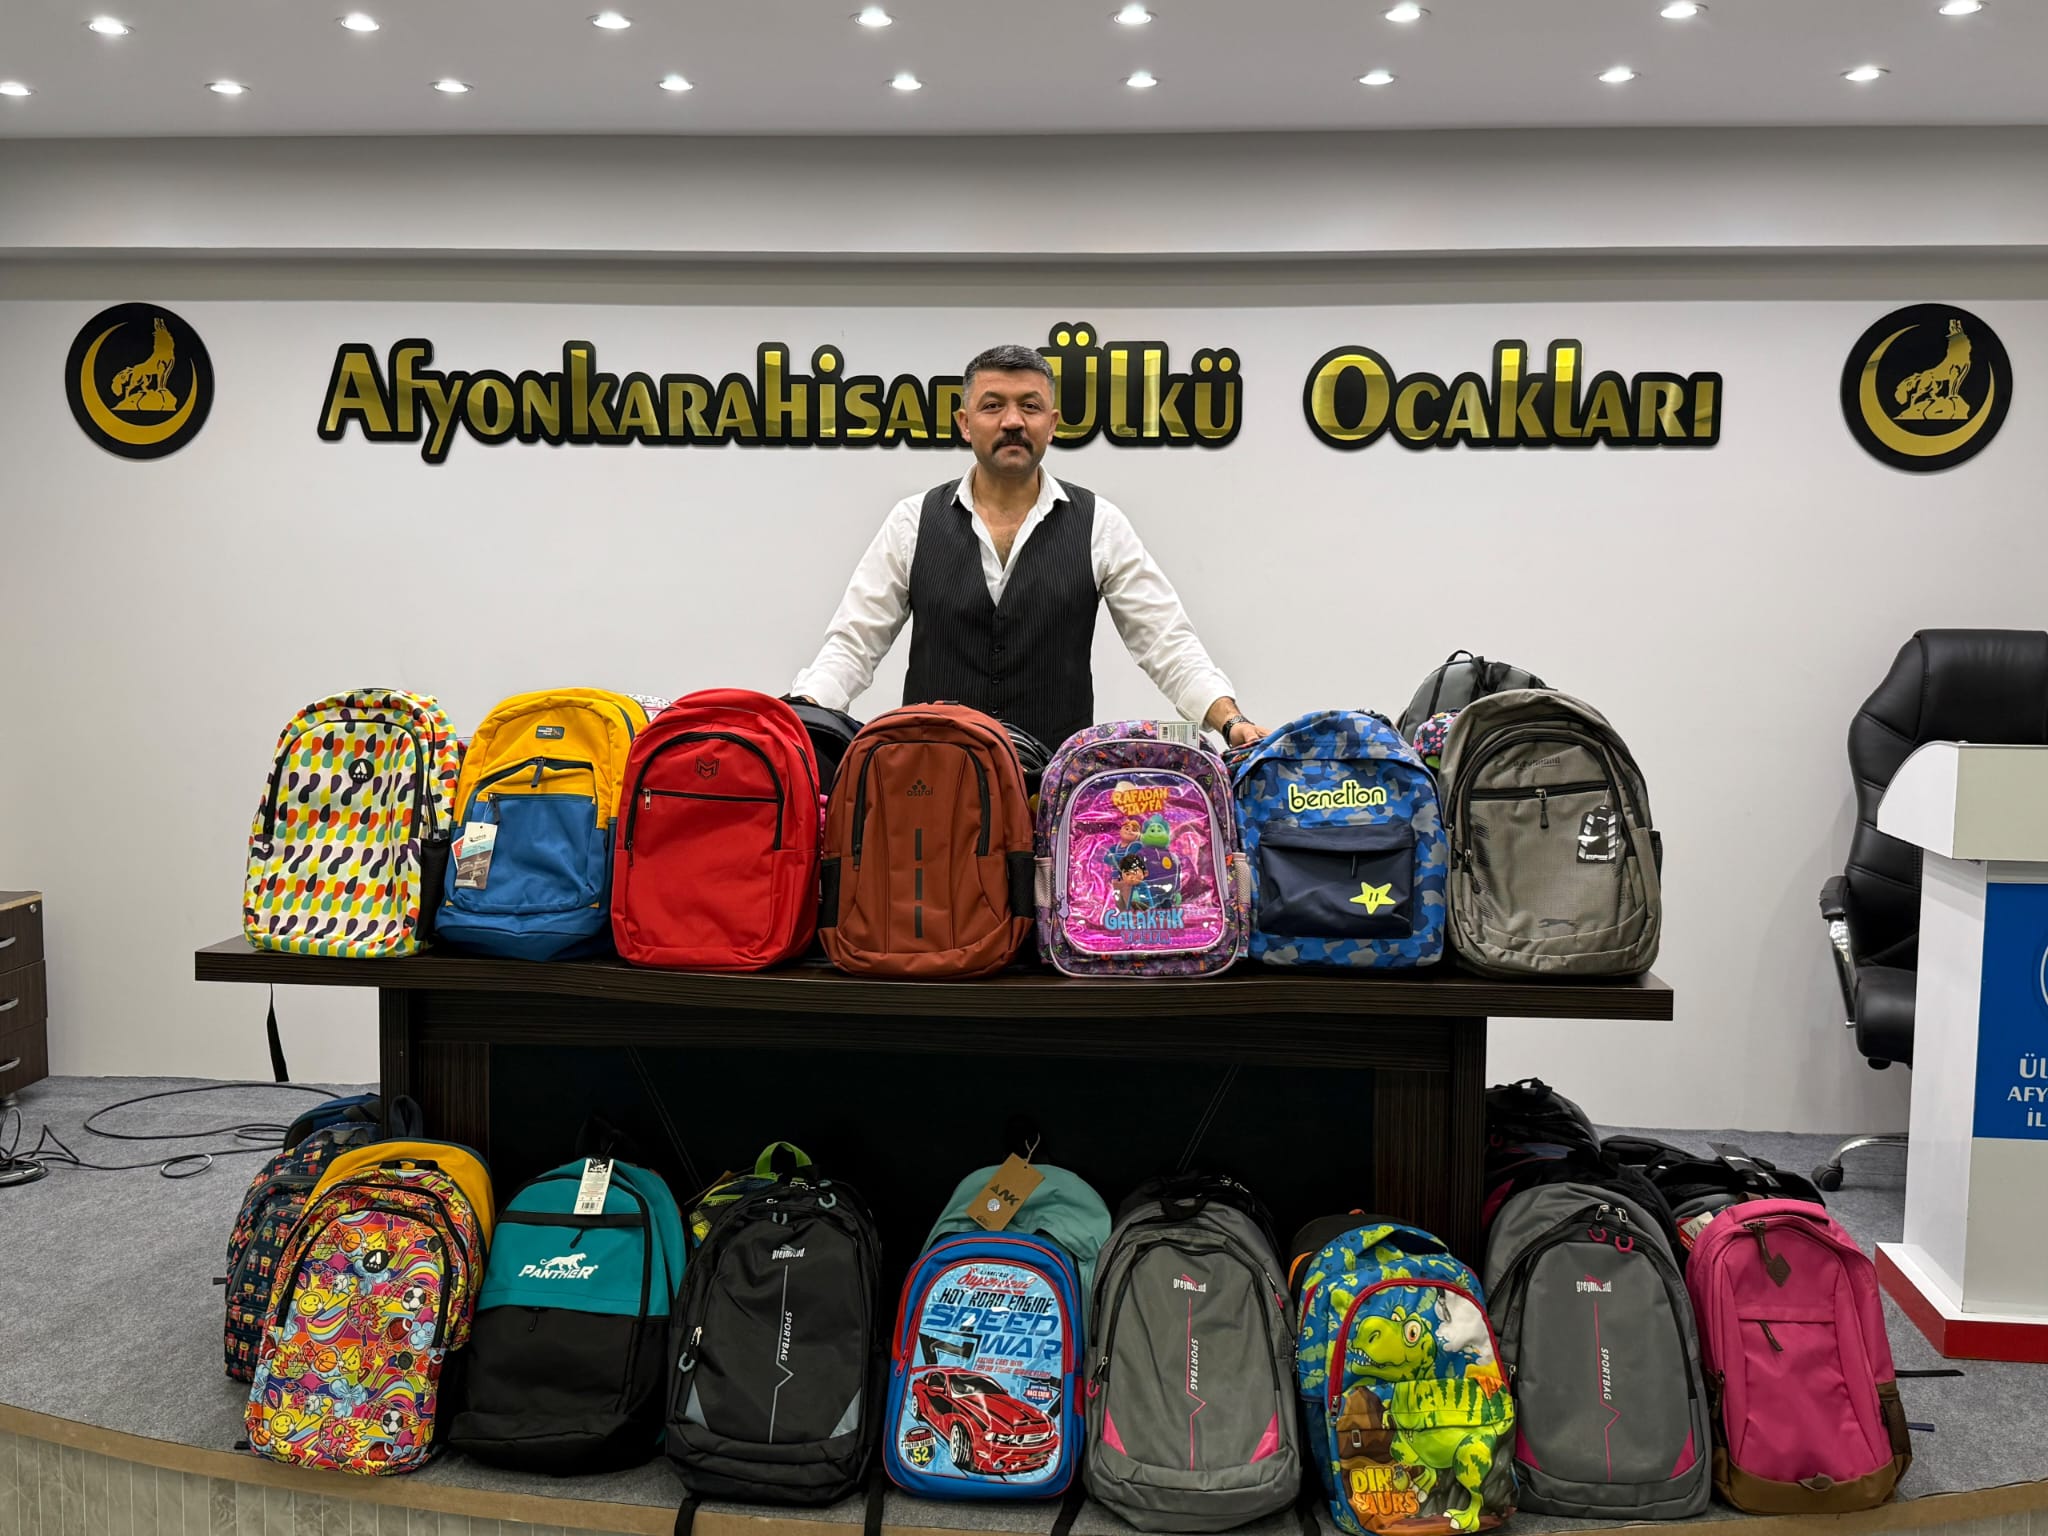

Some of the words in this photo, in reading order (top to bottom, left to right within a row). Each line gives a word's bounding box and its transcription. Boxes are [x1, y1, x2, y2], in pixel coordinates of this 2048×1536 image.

[1043, 326, 1239, 442] Ülkü
[1112, 787, 1169, 806] RAFADAN
[1117, 799, 1163, 816] TAYFA
[1289, 780, 1387, 812] benetton
[1104, 908, 1185, 931] GALAKTIK
[2027, 1107, 2047, 1127] İL
[518, 1264, 596, 1280] PANTHER
[939, 1288, 966, 1305] HOT
[968, 1291, 1005, 1309] ROAD
[1007, 1295, 1055, 1314] ENGINE
[925, 1304, 1060, 1337] SPEED
[780, 1311, 793, 1361] SPORTBAG
[980, 1333, 1062, 1361] WAR
[1189, 1337, 1200, 1391] SPORTBAG
[1600, 1347, 1612, 1401] SPORTBAG
[912, 1446, 930, 1463] 52
